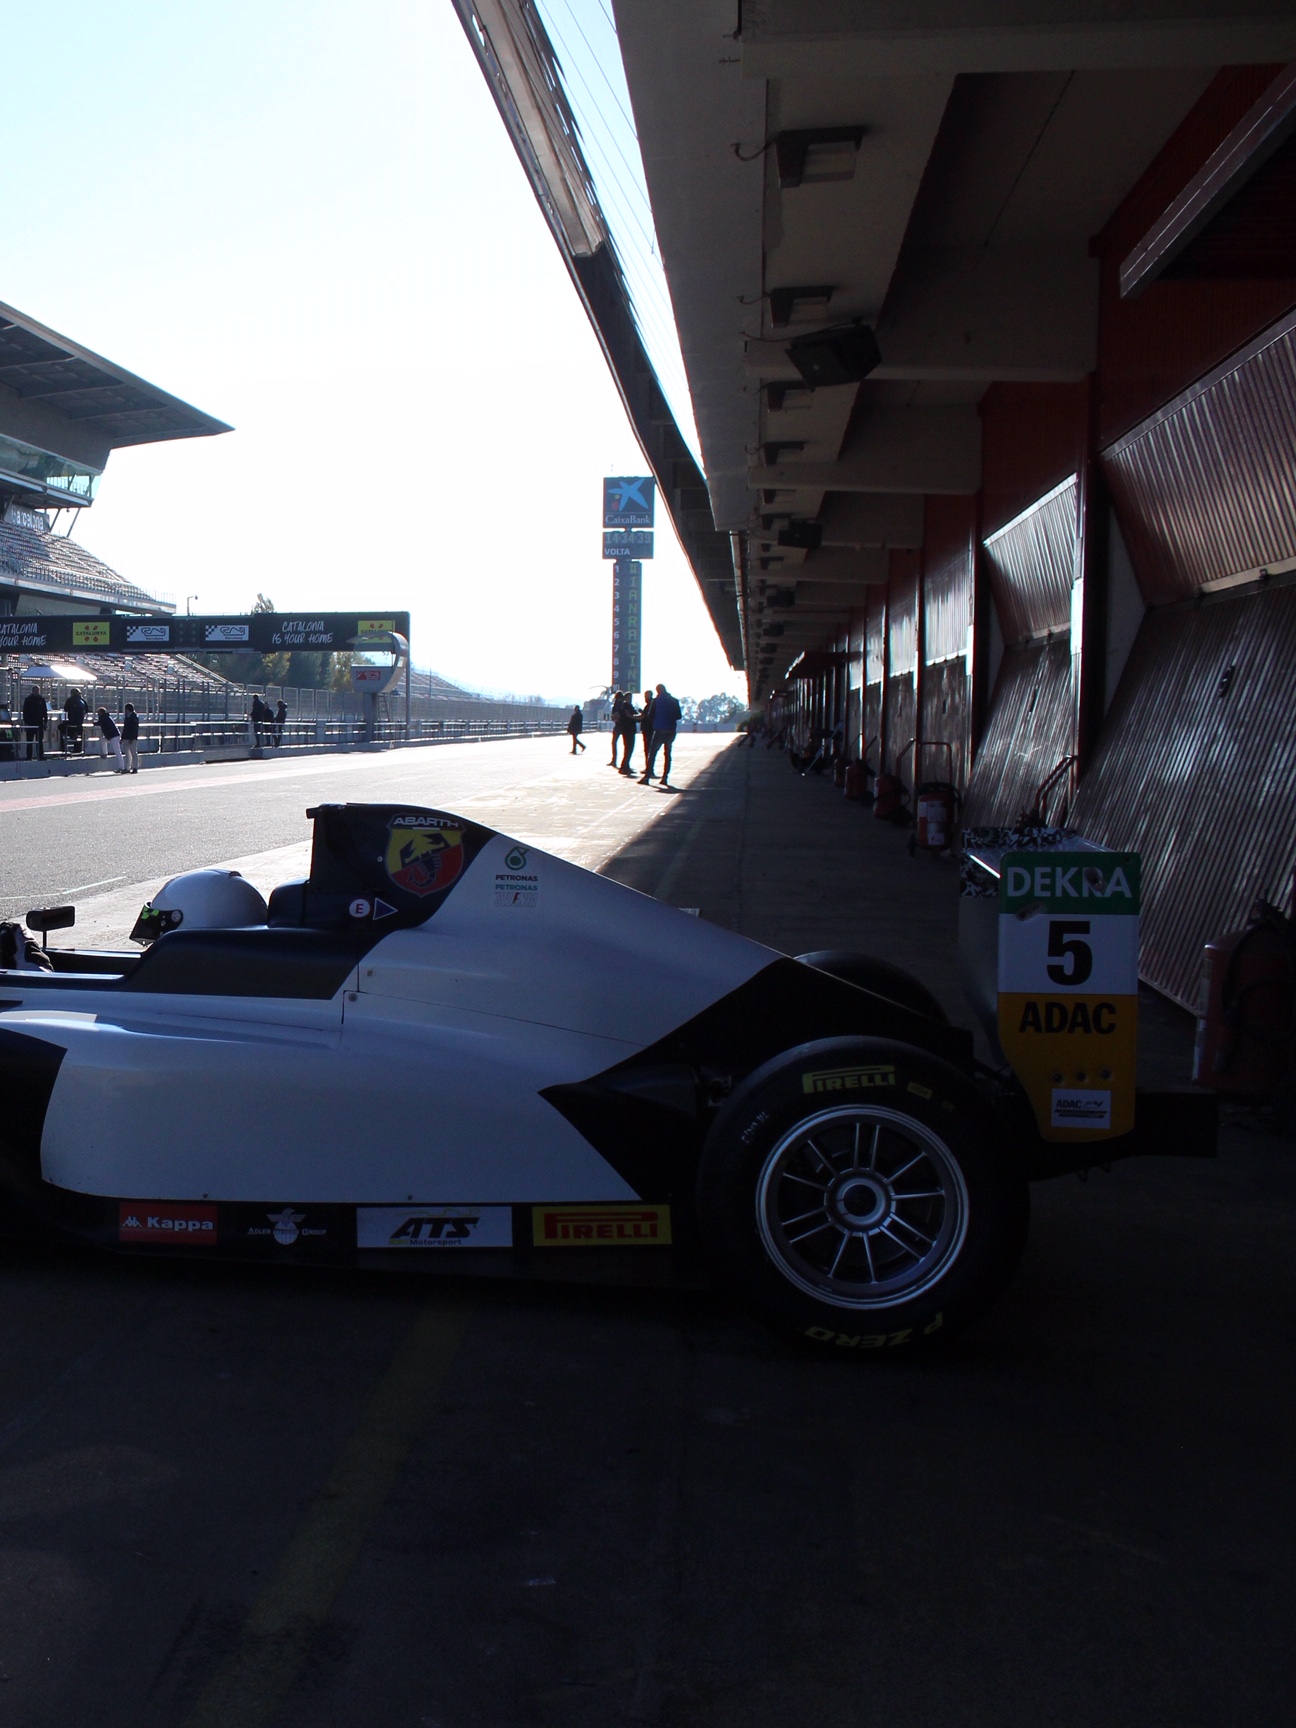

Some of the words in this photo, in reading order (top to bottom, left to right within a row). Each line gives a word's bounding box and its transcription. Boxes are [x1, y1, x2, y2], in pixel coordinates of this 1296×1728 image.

[605, 514, 651, 524] CaixaBank
[281, 620, 324, 633] CATALONIA
[21, 634, 47, 646] HOME
[272, 633, 282, 645] IS
[284, 632, 306, 645] YOUR
[307, 632, 334, 643] HOME
[393, 816, 459, 828] ABARTH
[495, 874, 539, 882] PETRONAS
[1006, 866, 1133, 898] DEKRA
[355, 903, 364, 914] E
[1046, 920, 1093, 986] 5
[1018, 1001, 1116, 1035] ADAC
[802, 1064, 896, 1094] PIRELLI
[1055, 1099, 1083, 1109] ADAC
[147, 1215, 214, 1232] Kappa
[390, 1217, 481, 1239] ATS
[544, 1211, 659, 1240] PIRELLI
[247, 1226, 271, 1235] ADLER
[301, 1227, 327, 1236] GROUP
[409, 1238, 462, 1247] Motorsport
[922, 1311, 944, 1335] P
[804, 1325, 913, 1349] ZERO
